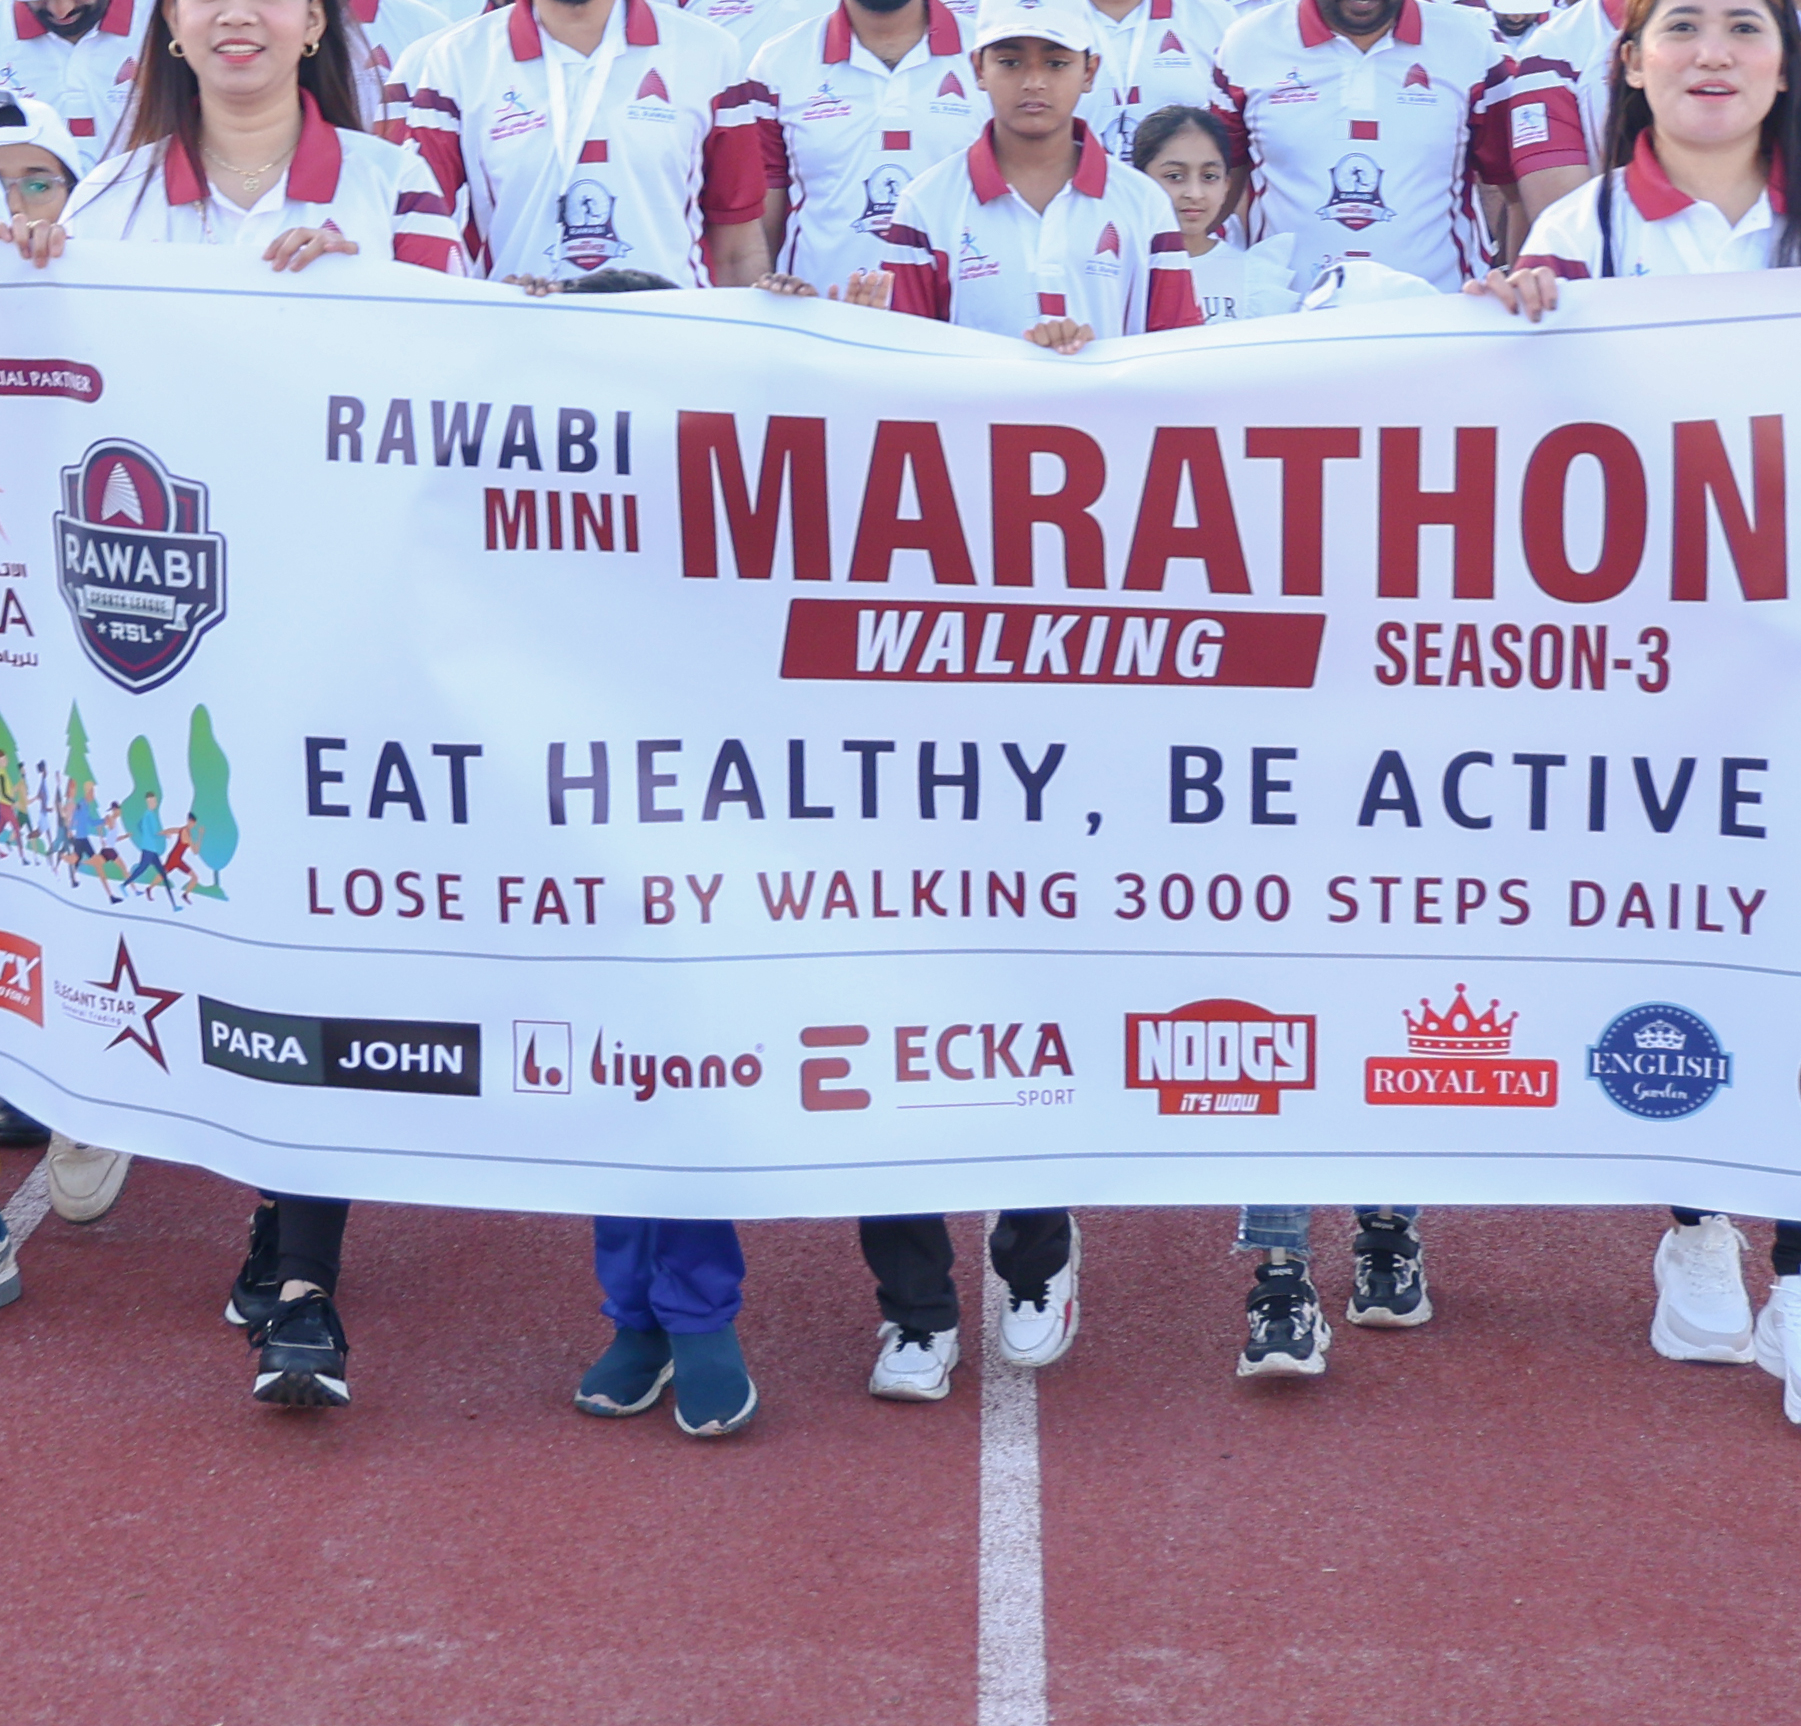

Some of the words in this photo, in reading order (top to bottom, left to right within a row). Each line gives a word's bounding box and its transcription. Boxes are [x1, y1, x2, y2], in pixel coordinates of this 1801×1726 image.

[29, 370, 92, 393] PARTNER
[326, 395, 631, 476] RAWABI
[484, 487, 640, 553] MINI
[677, 409, 1789, 603] MARATHON
[64, 533, 207, 590] RAWABI
[110, 621, 153, 643] RSL
[856, 609, 1226, 679] WALKING
[1374, 621, 1670, 693] SEASON-3
[304, 736, 483, 824] EAT
[546, 738, 1104, 836] HEALTHY,
[1169, 745, 1298, 826] BE
[1357, 750, 1770, 839] ACTIVE
[308, 867, 465, 921] LOSE
[499, 876, 606, 925] FAT
[642, 874, 724, 925] BY
[757, 869, 1078, 922] WALKING
[1114, 873, 1291, 922] 3000
[1326, 876, 1531, 925] STEPS
[1569, 880, 1768, 936] DAILY
[54, 980, 98, 1009] ELEGANT
[100, 996, 137, 1015] STAR
[210, 1020, 308, 1066] PARA
[338, 1041, 463, 1074] JOHN
[894, 1023, 1074, 1082] ECKA
[1137, 1020, 1308, 1082] NOOGY
[1591, 1052, 1727, 1081] ENGLISH
[1016, 1089, 1075, 1108] SPORT
[1213, 1093, 1261, 1113] WOW
[1372, 1068, 1486, 1095] ROYAL
[1492, 1070, 1550, 1098] TAJ
[1632, 1081, 1689, 1102] Garden
